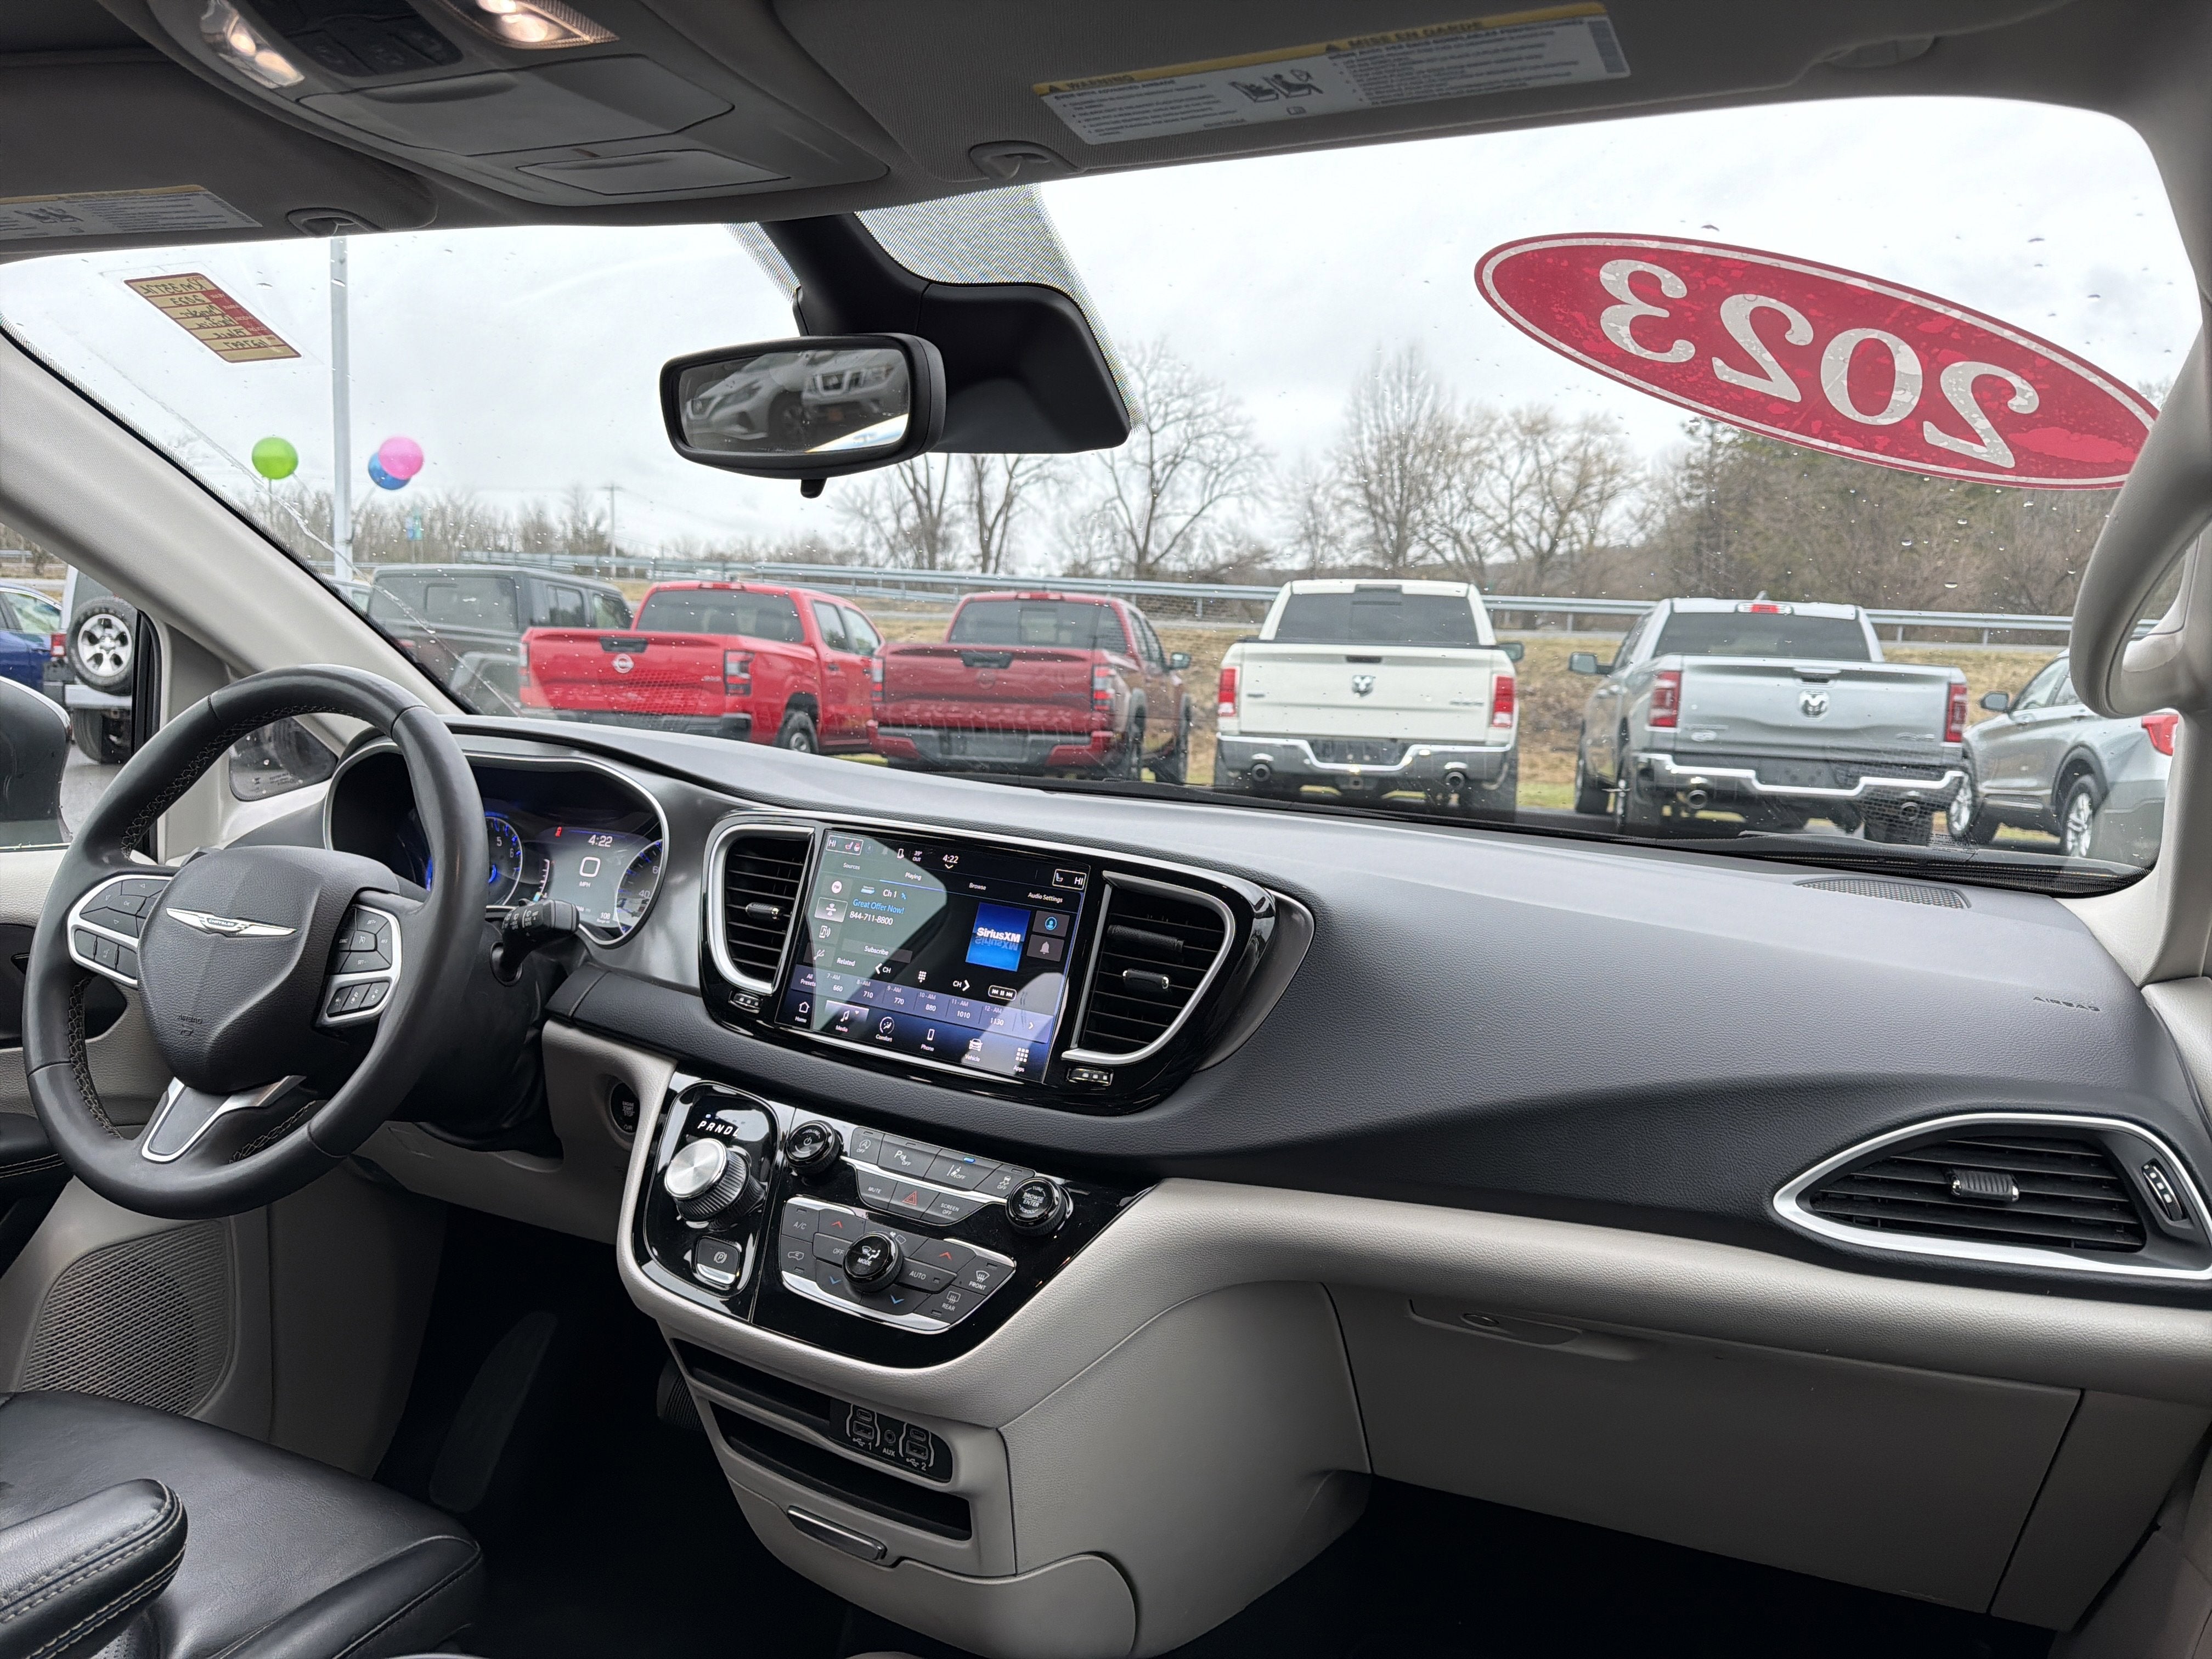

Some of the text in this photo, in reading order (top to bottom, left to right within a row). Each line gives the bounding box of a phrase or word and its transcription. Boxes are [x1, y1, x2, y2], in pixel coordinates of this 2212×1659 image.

[496, 836, 503, 847] 5
[588, 834, 613, 848] 4:22
[943, 854, 959, 864] 4:22
[905, 872, 922, 881] Playing
[1074, 877, 1084, 885] HI
[969, 882, 986, 890] Browse
[639, 889, 651, 899] 40
[883, 889, 892, 897] Ch
[1043, 894, 1063, 904] Settings
[853, 899, 905, 915] Great Offer Now!
[208, 918, 235, 927] CHRYSLER
[849, 911, 894, 926] 844-711-8800
[977, 927, 1021, 943] SiriusXM
[864, 945, 889, 956] Subscribe
[837, 957, 856, 967] Related
[800, 979, 816, 987] Presets
[863, 990, 874, 998] 710
[894, 997, 904, 1005] 770
[2033, 996, 2101, 1012] AIRBAG
[925, 1003, 936, 1012] 880
[957, 1010, 970, 1019] 1010
[990, 1017, 1004, 1026] 1130
[875, 1034, 893, 1042] Comfort
[920, 1043, 934, 1052] Phone
[964, 1054, 980, 1062] Vehicle
[1013, 1065, 1025, 1073] Apps
[868, 1186, 882, 1194] MUTE
[1023, 1192, 1045, 1202] BROWSE
[940, 1202, 960, 1212] SCREEN
[1023, 1199, 1040, 1207] ENTER
[793, 1221, 807, 1229] A/C
[857, 1257, 873, 1266] MODE
[909, 1270, 927, 1280] AUTO
[969, 1280, 987, 1290] FRONT
[941, 1302, 956, 1312] REAR
[882, 1447, 895, 1457] AUX
[921, 1462, 927, 1471] 2
